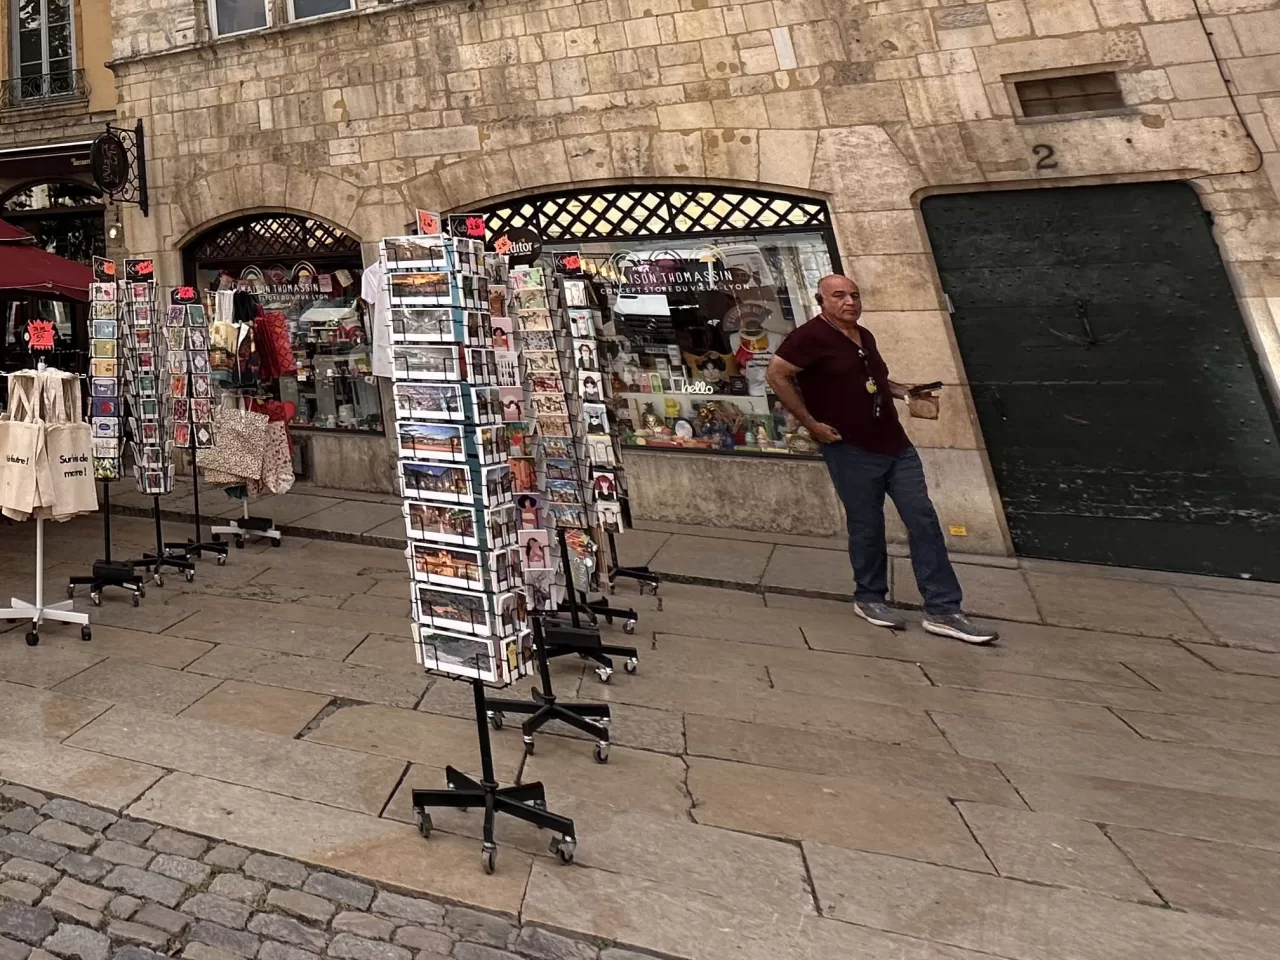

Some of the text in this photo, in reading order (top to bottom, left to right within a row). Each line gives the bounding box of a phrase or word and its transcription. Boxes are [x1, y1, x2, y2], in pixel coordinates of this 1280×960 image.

[1032, 144, 1058, 170] 2
[662, 270, 733, 284] THOMASSIN
[273, 284, 319, 293] THOMASSIN
[681, 380, 714, 394] hello
